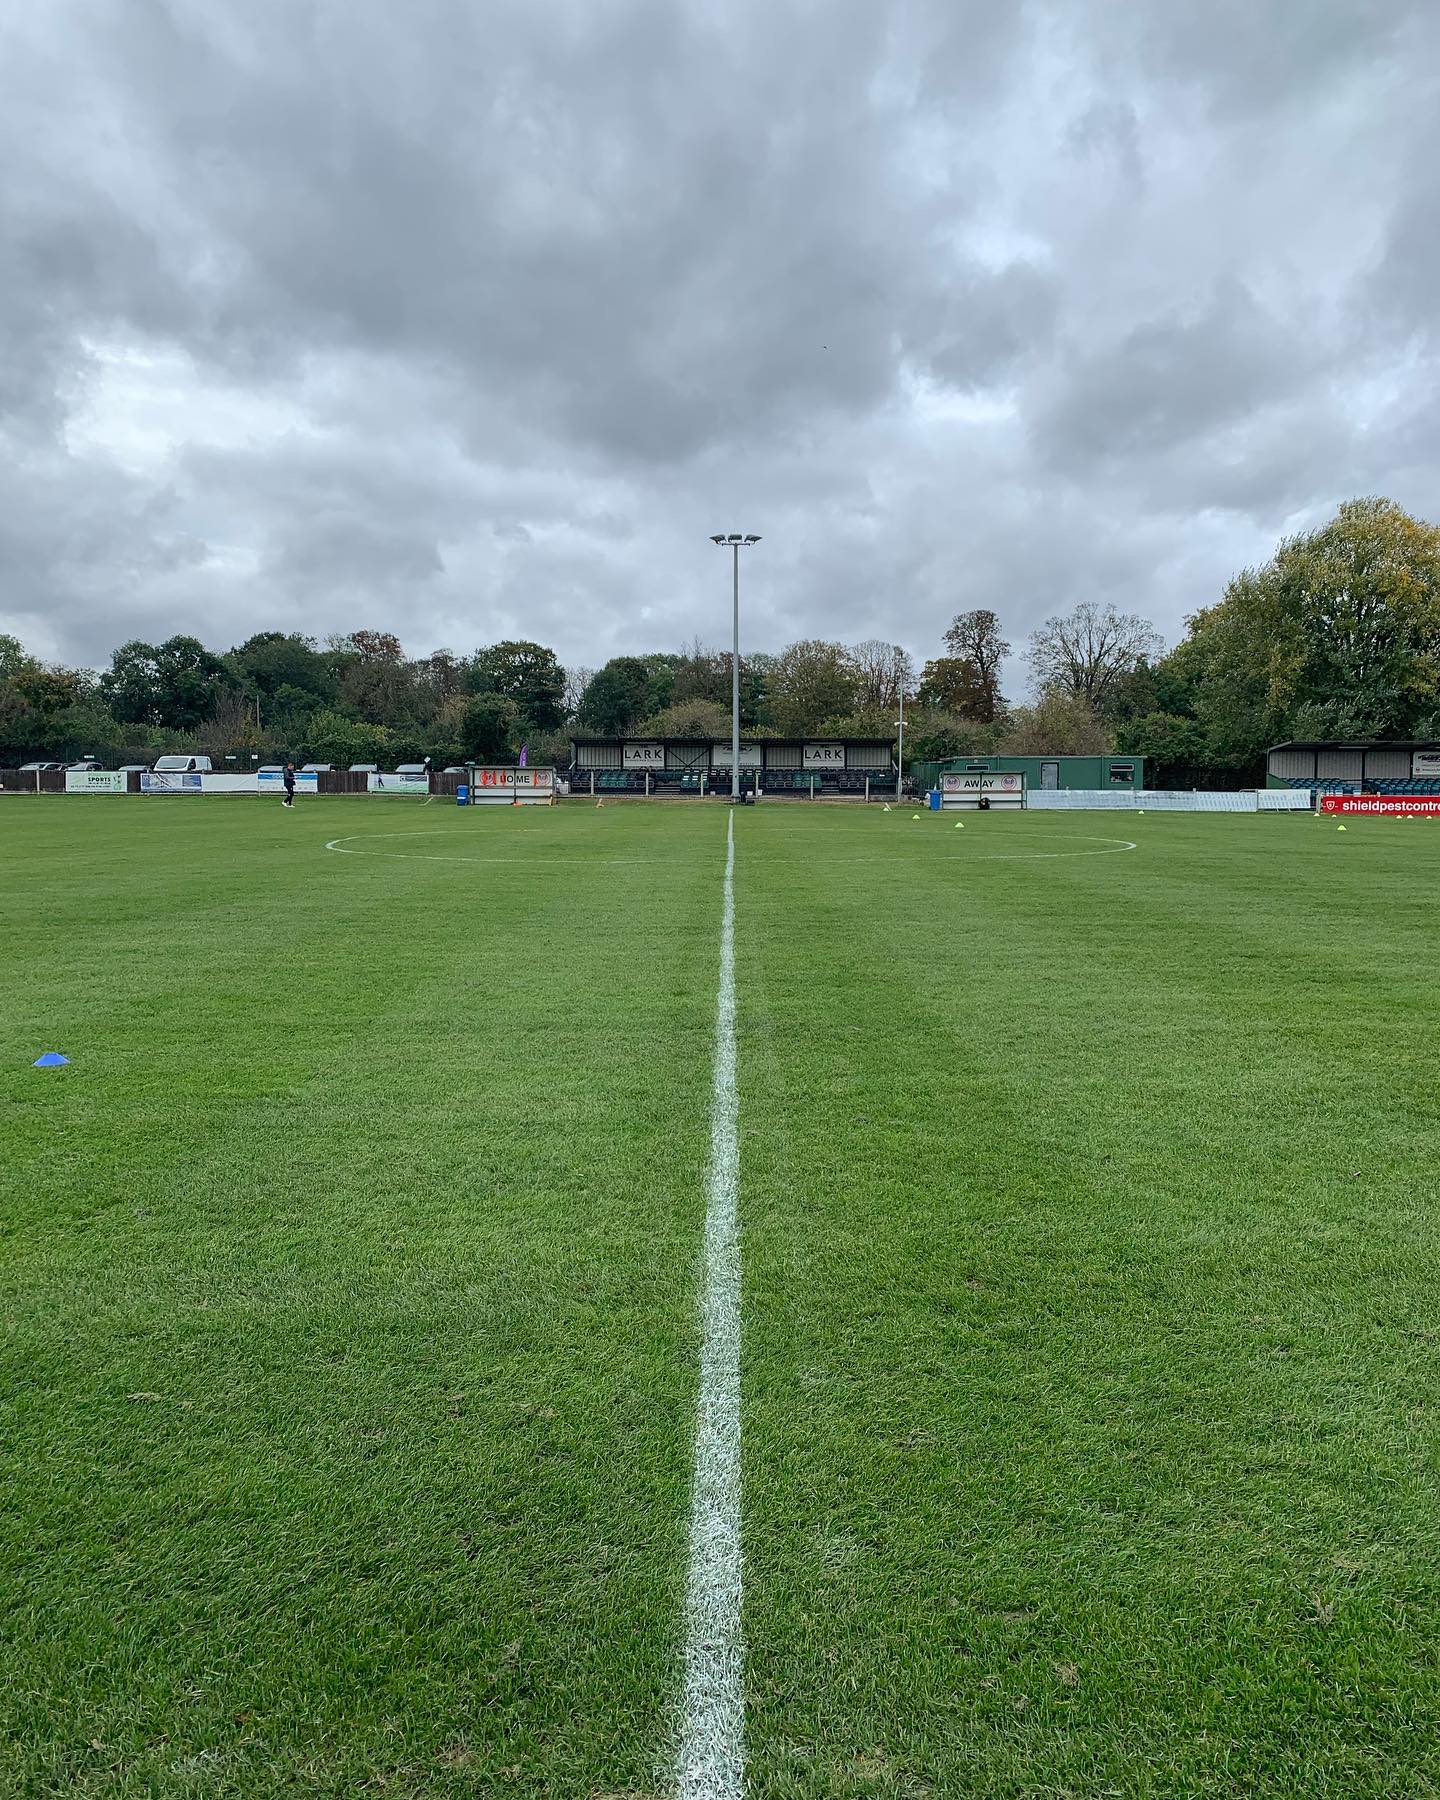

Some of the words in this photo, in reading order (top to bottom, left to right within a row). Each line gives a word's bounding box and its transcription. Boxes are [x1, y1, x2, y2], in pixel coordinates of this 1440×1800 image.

[625, 750, 662, 759] LARK
[805, 750, 842, 759] LARK
[964, 780, 995, 788] AWAY
